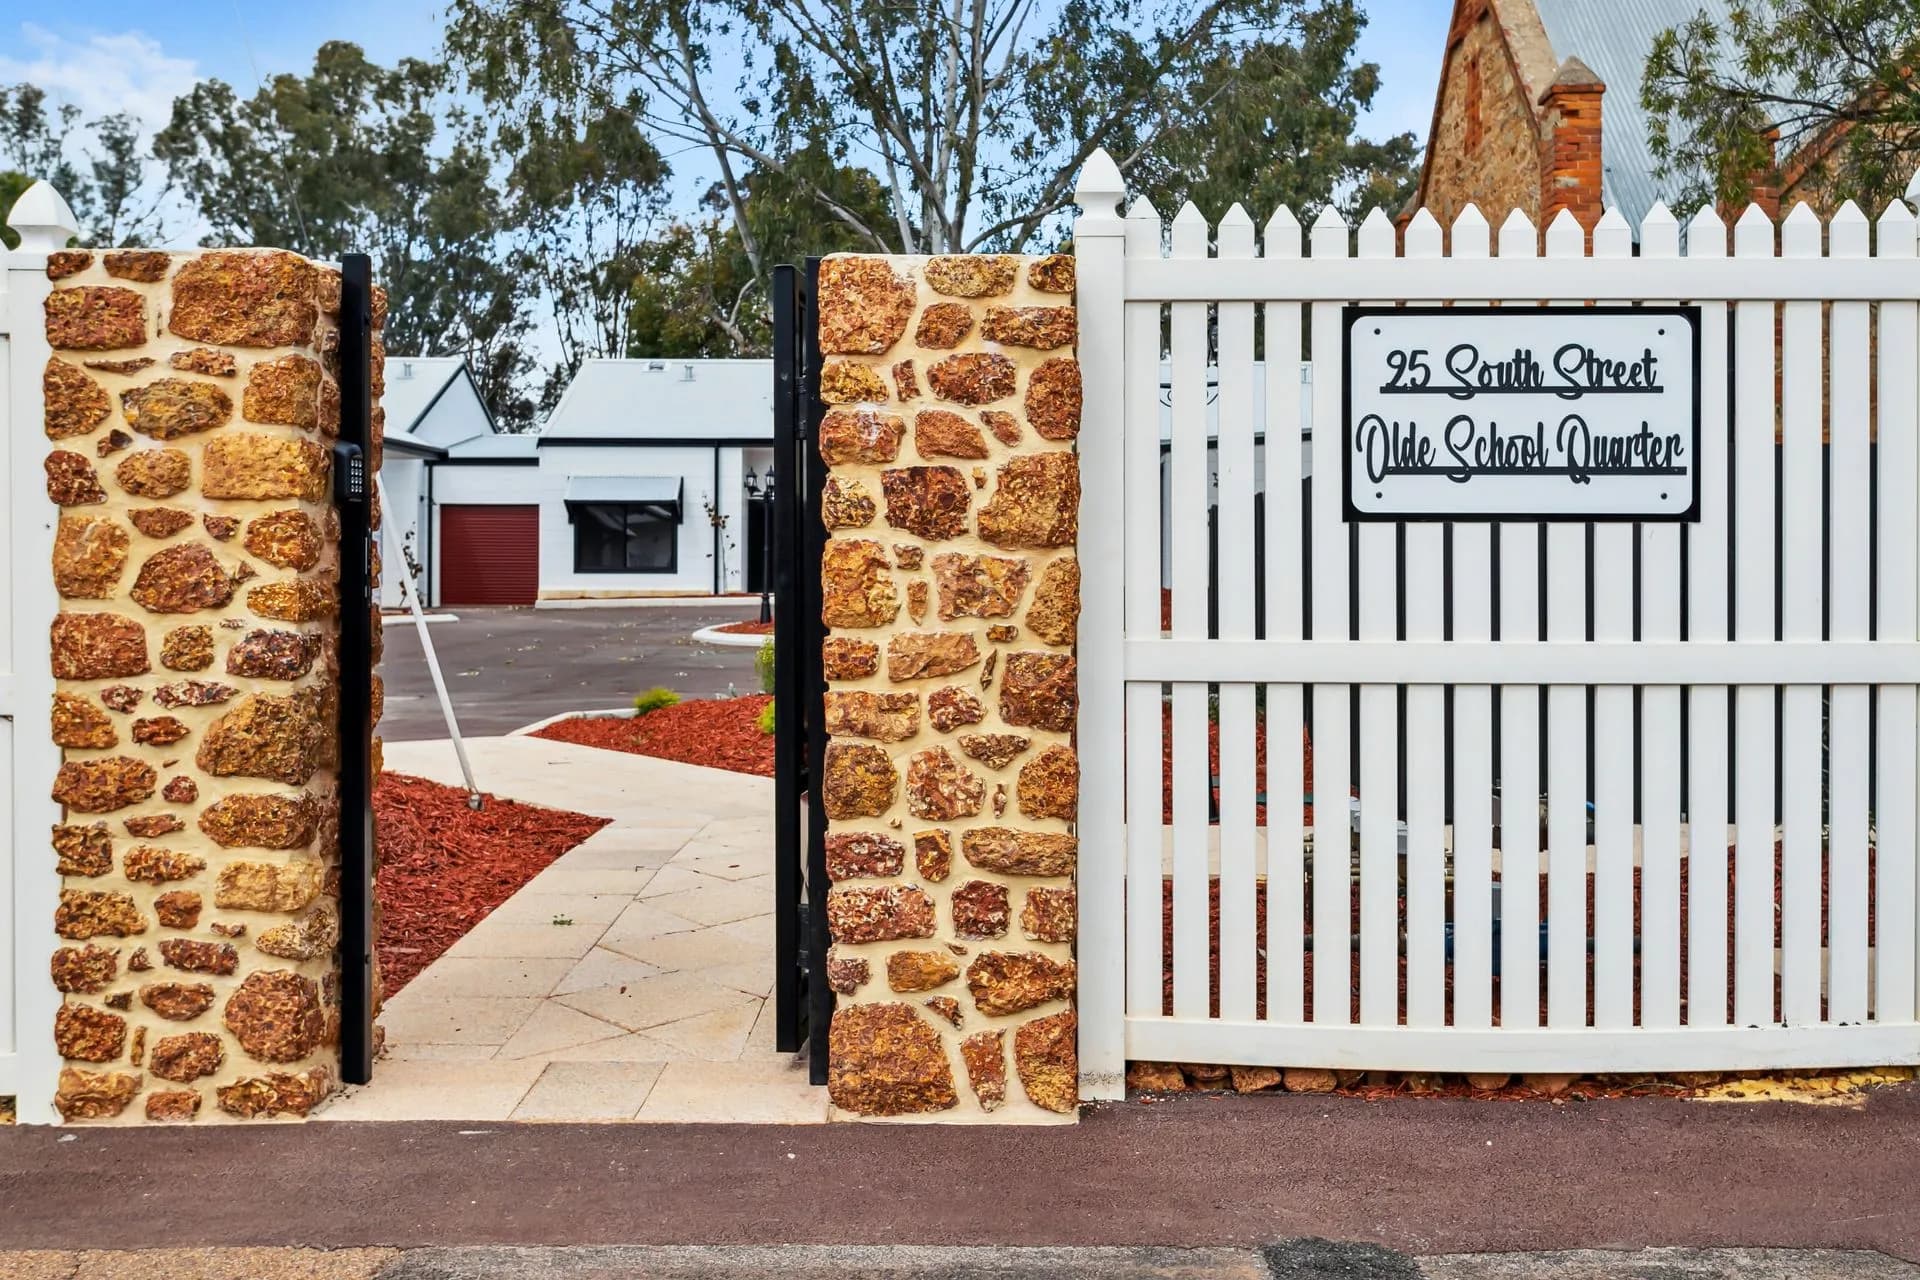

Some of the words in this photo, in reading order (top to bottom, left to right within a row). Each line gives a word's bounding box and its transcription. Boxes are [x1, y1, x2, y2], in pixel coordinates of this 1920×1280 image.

[1386, 350, 1431, 388] 25
[1445, 343, 1544, 400] South
[1553, 343, 1658, 400] Street
[1355, 414, 1436, 483] Olde
[1444, 414, 1548, 483] School
[1556, 414, 1684, 485] Quarter
